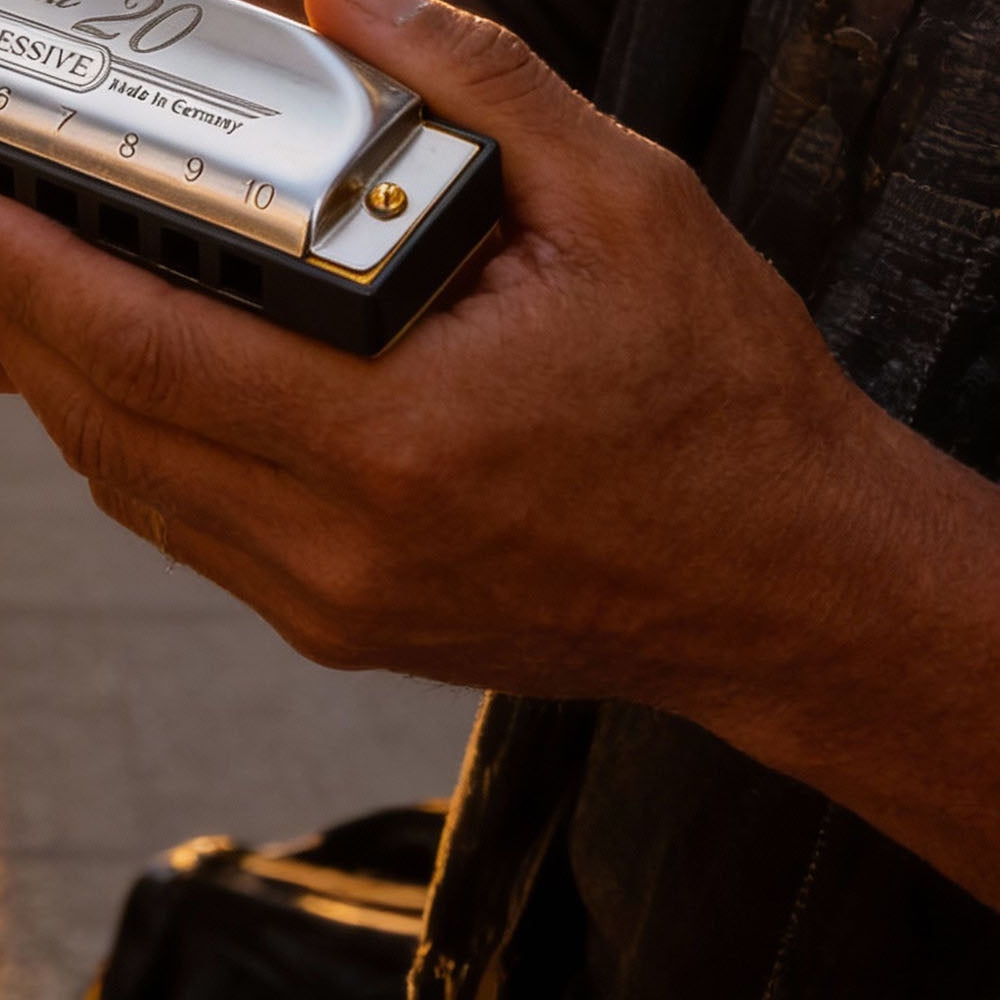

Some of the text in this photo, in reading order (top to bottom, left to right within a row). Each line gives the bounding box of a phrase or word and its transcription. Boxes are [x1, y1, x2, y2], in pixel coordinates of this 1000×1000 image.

[57, 105, 77, 131] 7
[118, 132, 139, 158] 8
[184, 156, 205, 182] 9
[244, 178, 276, 210] 10
